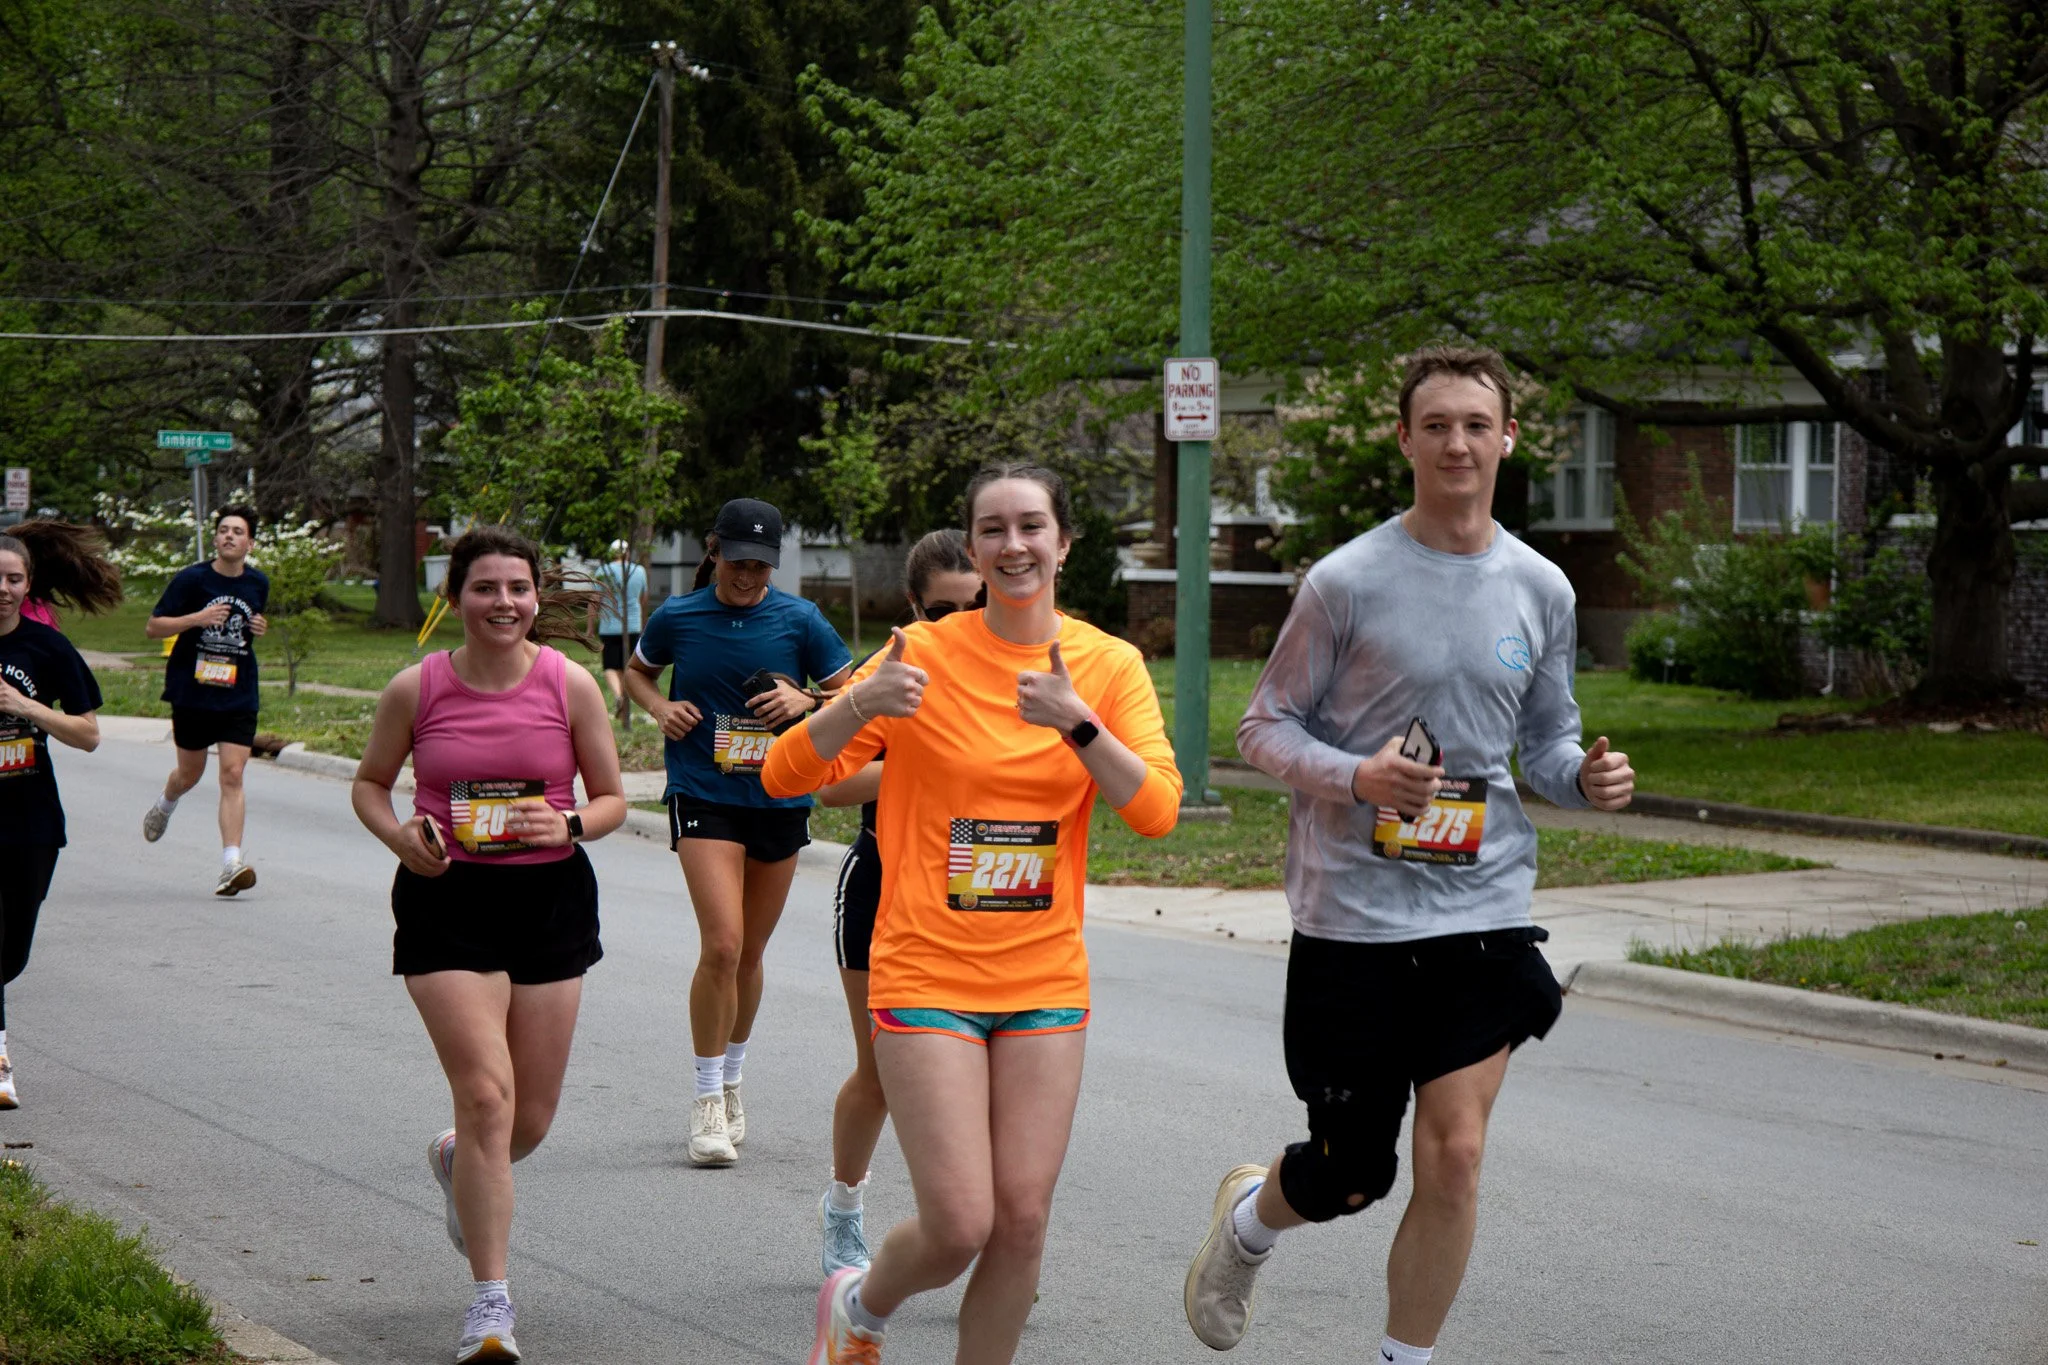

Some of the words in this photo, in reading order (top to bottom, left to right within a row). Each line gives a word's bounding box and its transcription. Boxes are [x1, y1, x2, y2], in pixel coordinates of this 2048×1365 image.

[1181, 366, 1200, 380] NO
[1169, 383, 1213, 398] PARKING
[159, 431, 203, 447] Lombard
[203, 595, 235, 611] OTTER'S
[5, 664, 38, 698] HOUSE
[971, 851, 1044, 890] 2274
